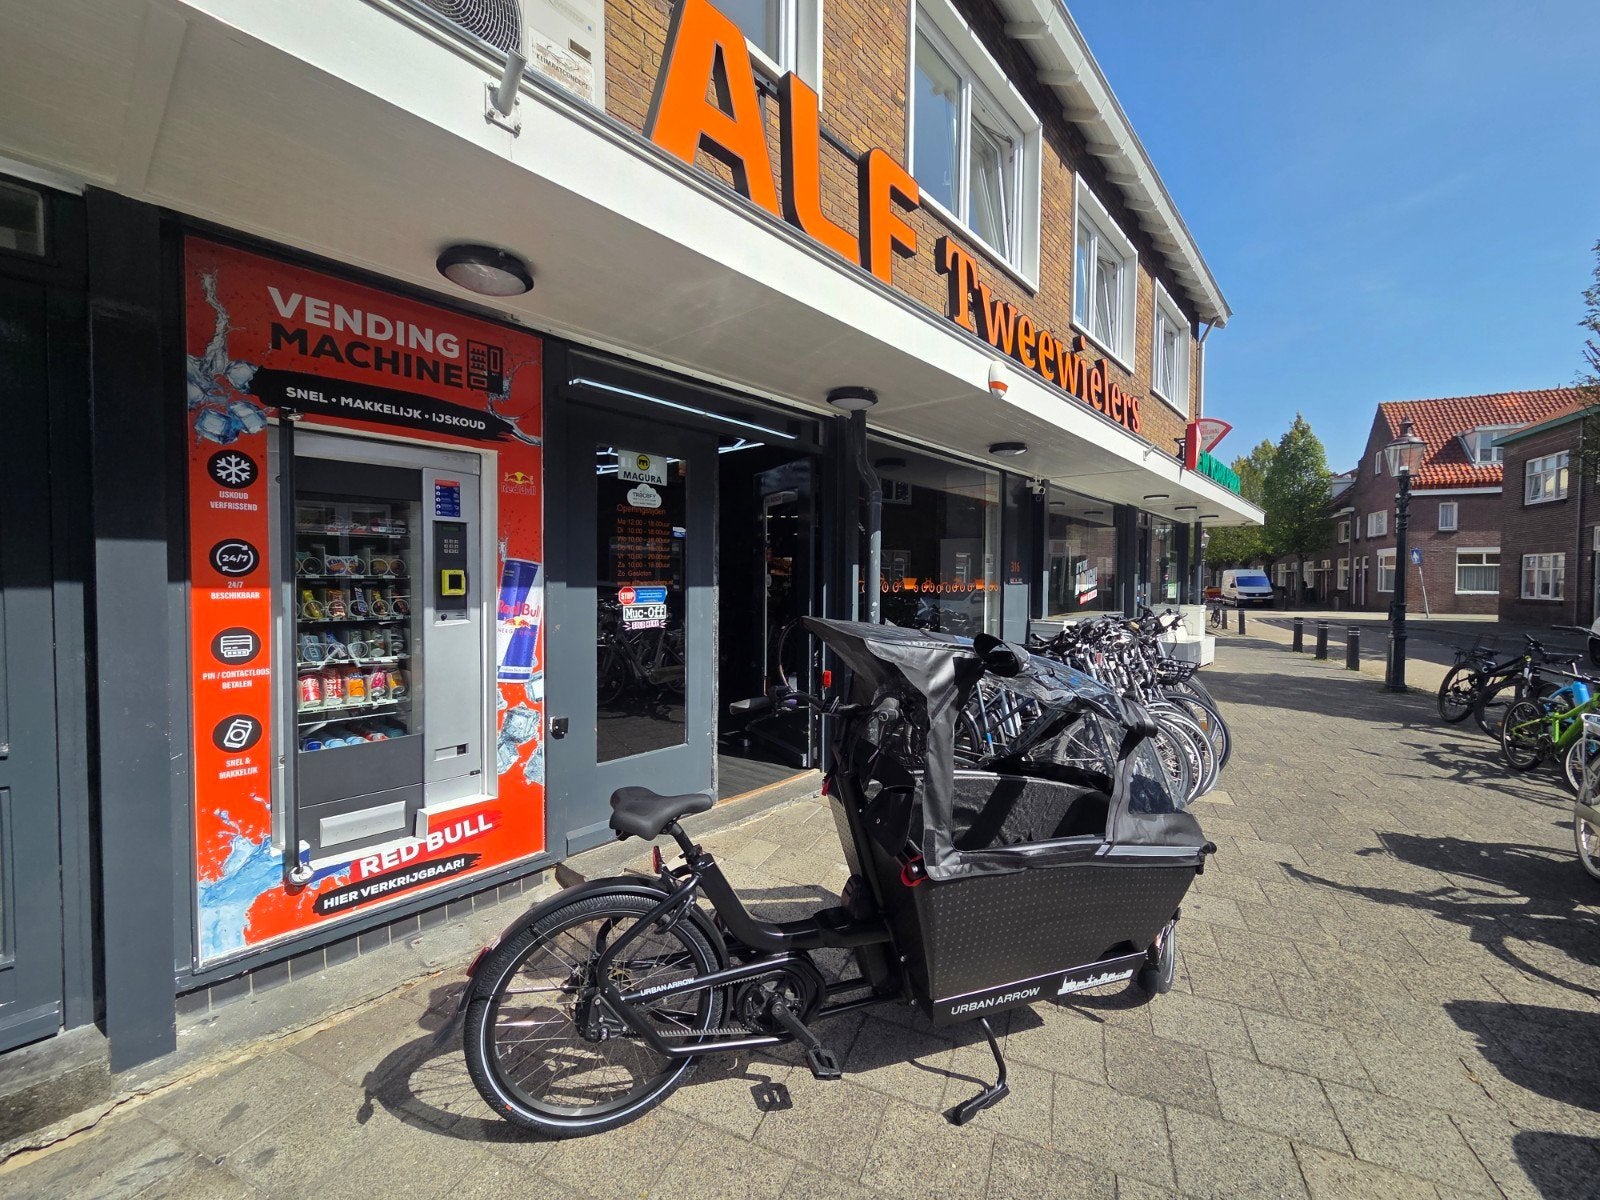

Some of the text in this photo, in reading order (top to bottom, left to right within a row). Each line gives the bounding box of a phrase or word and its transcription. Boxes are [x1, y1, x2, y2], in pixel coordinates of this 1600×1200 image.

[647, 0, 920, 286] ALF
[267, 286, 460, 358] VENDING
[937, 235, 1142, 433] Tweewielers
[270, 322, 464, 390] MACHINE
[286, 386, 486, 430] SNEL MAKKELIJK IJSKOUD
[623, 471, 662, 484] MAGURA
[219, 491, 249, 500] IJSKOUD
[501, 482, 537, 496] Red Bull
[210, 501, 258, 511] VERFRISSEND
[222, 554, 248, 562] 24/7
[228, 581, 244, 589] 24/7
[210, 592, 260, 600] BESCHIKBAAR
[625, 606, 666, 619] Muc-Off
[202, 672, 215, 680] PIN
[221, 668, 271, 678] CONTACTLOOS
[222, 681, 252, 690] BETALEN
[226, 756, 251, 768] SNEL &
[218, 767, 258, 780] MAKKELIJK
[359, 814, 493, 878] RED BULL
[323, 858, 465, 910] HIER VERKRIJGBAAR!
[640, 978, 694, 996] URBAN ARROW
[950, 986, 1040, 1015] URBAN ARROW
